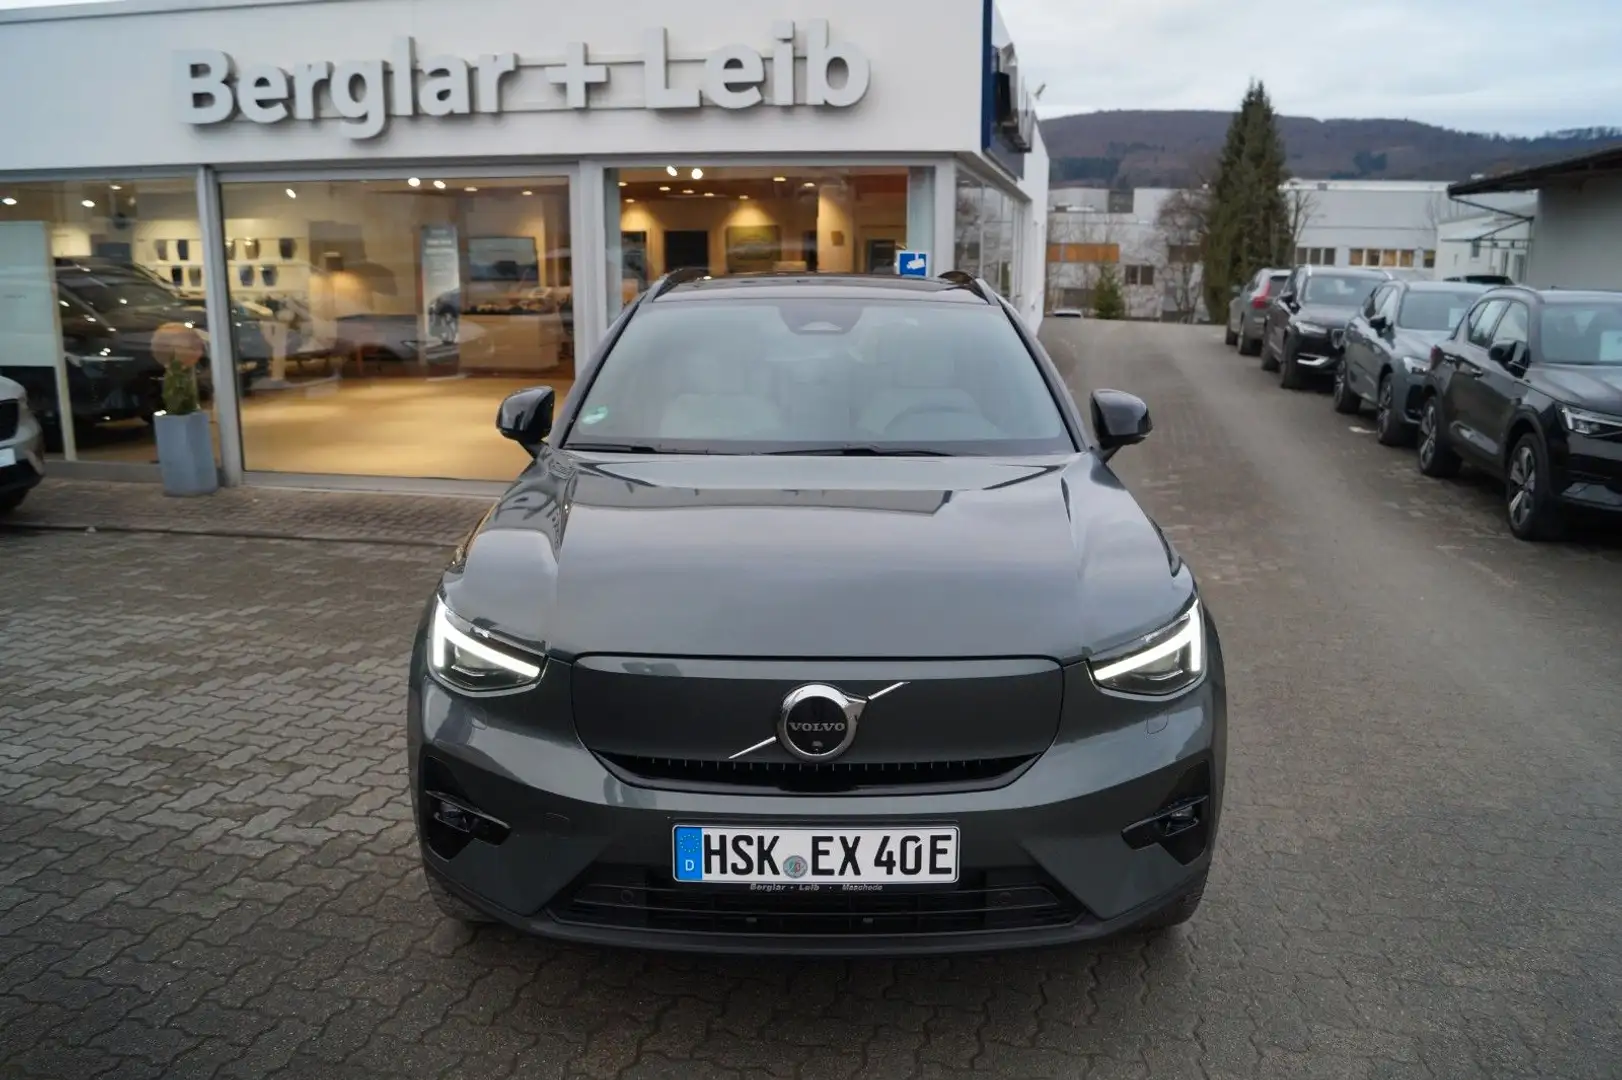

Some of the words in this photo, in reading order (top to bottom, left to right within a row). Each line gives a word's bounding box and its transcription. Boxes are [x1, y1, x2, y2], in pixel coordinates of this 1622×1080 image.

[172, 36, 518, 140] Berglar
[545, 42, 609, 108] +
[644, 18, 870, 109] Leib
[788, 722, 846, 731] VOLVO
[703, 834, 780, 876] HSK
[811, 836, 861, 876] EX
[874, 835, 952, 876] 40E
[685, 859, 695, 871] D
[750, 883, 786, 891] Berglar
